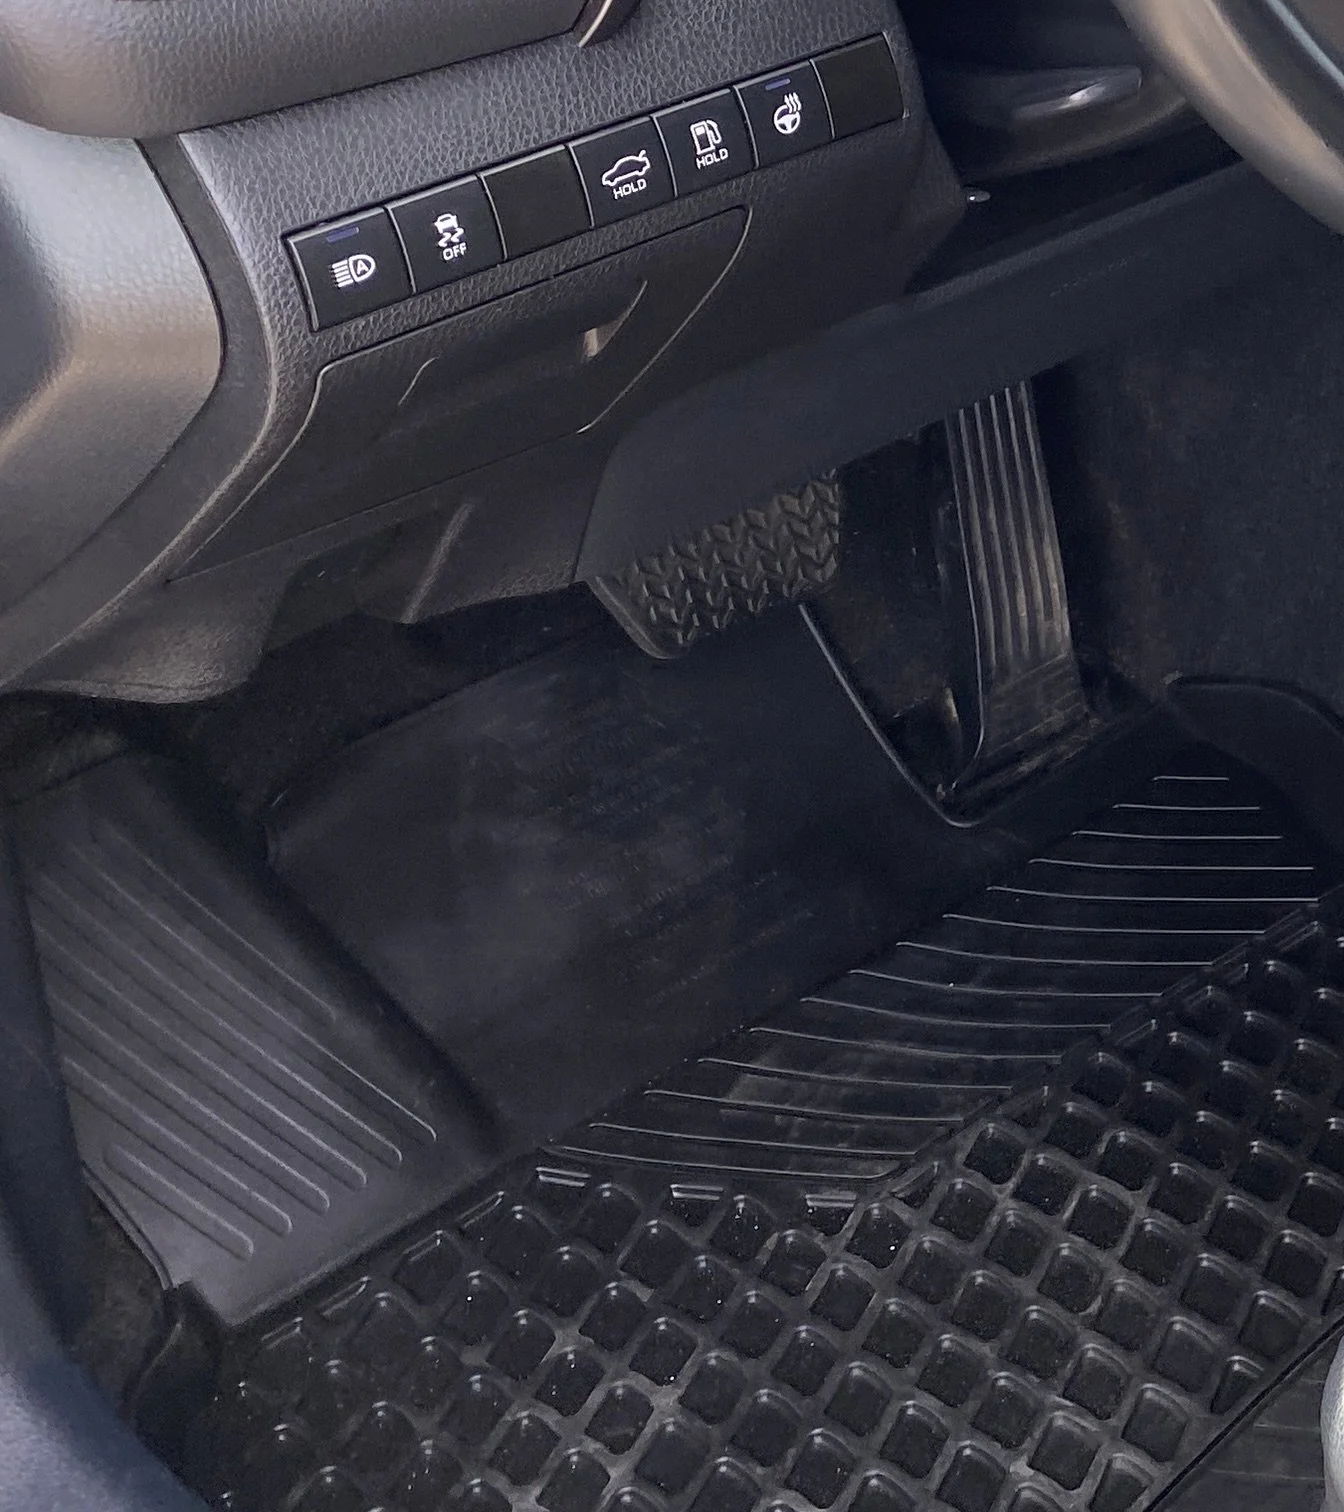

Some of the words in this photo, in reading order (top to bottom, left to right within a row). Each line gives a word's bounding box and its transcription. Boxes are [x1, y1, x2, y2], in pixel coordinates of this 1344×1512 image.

[695, 147, 729, 170] HOLD
[612, 178, 647, 200] HOLD
[442, 242, 468, 261] OFF
